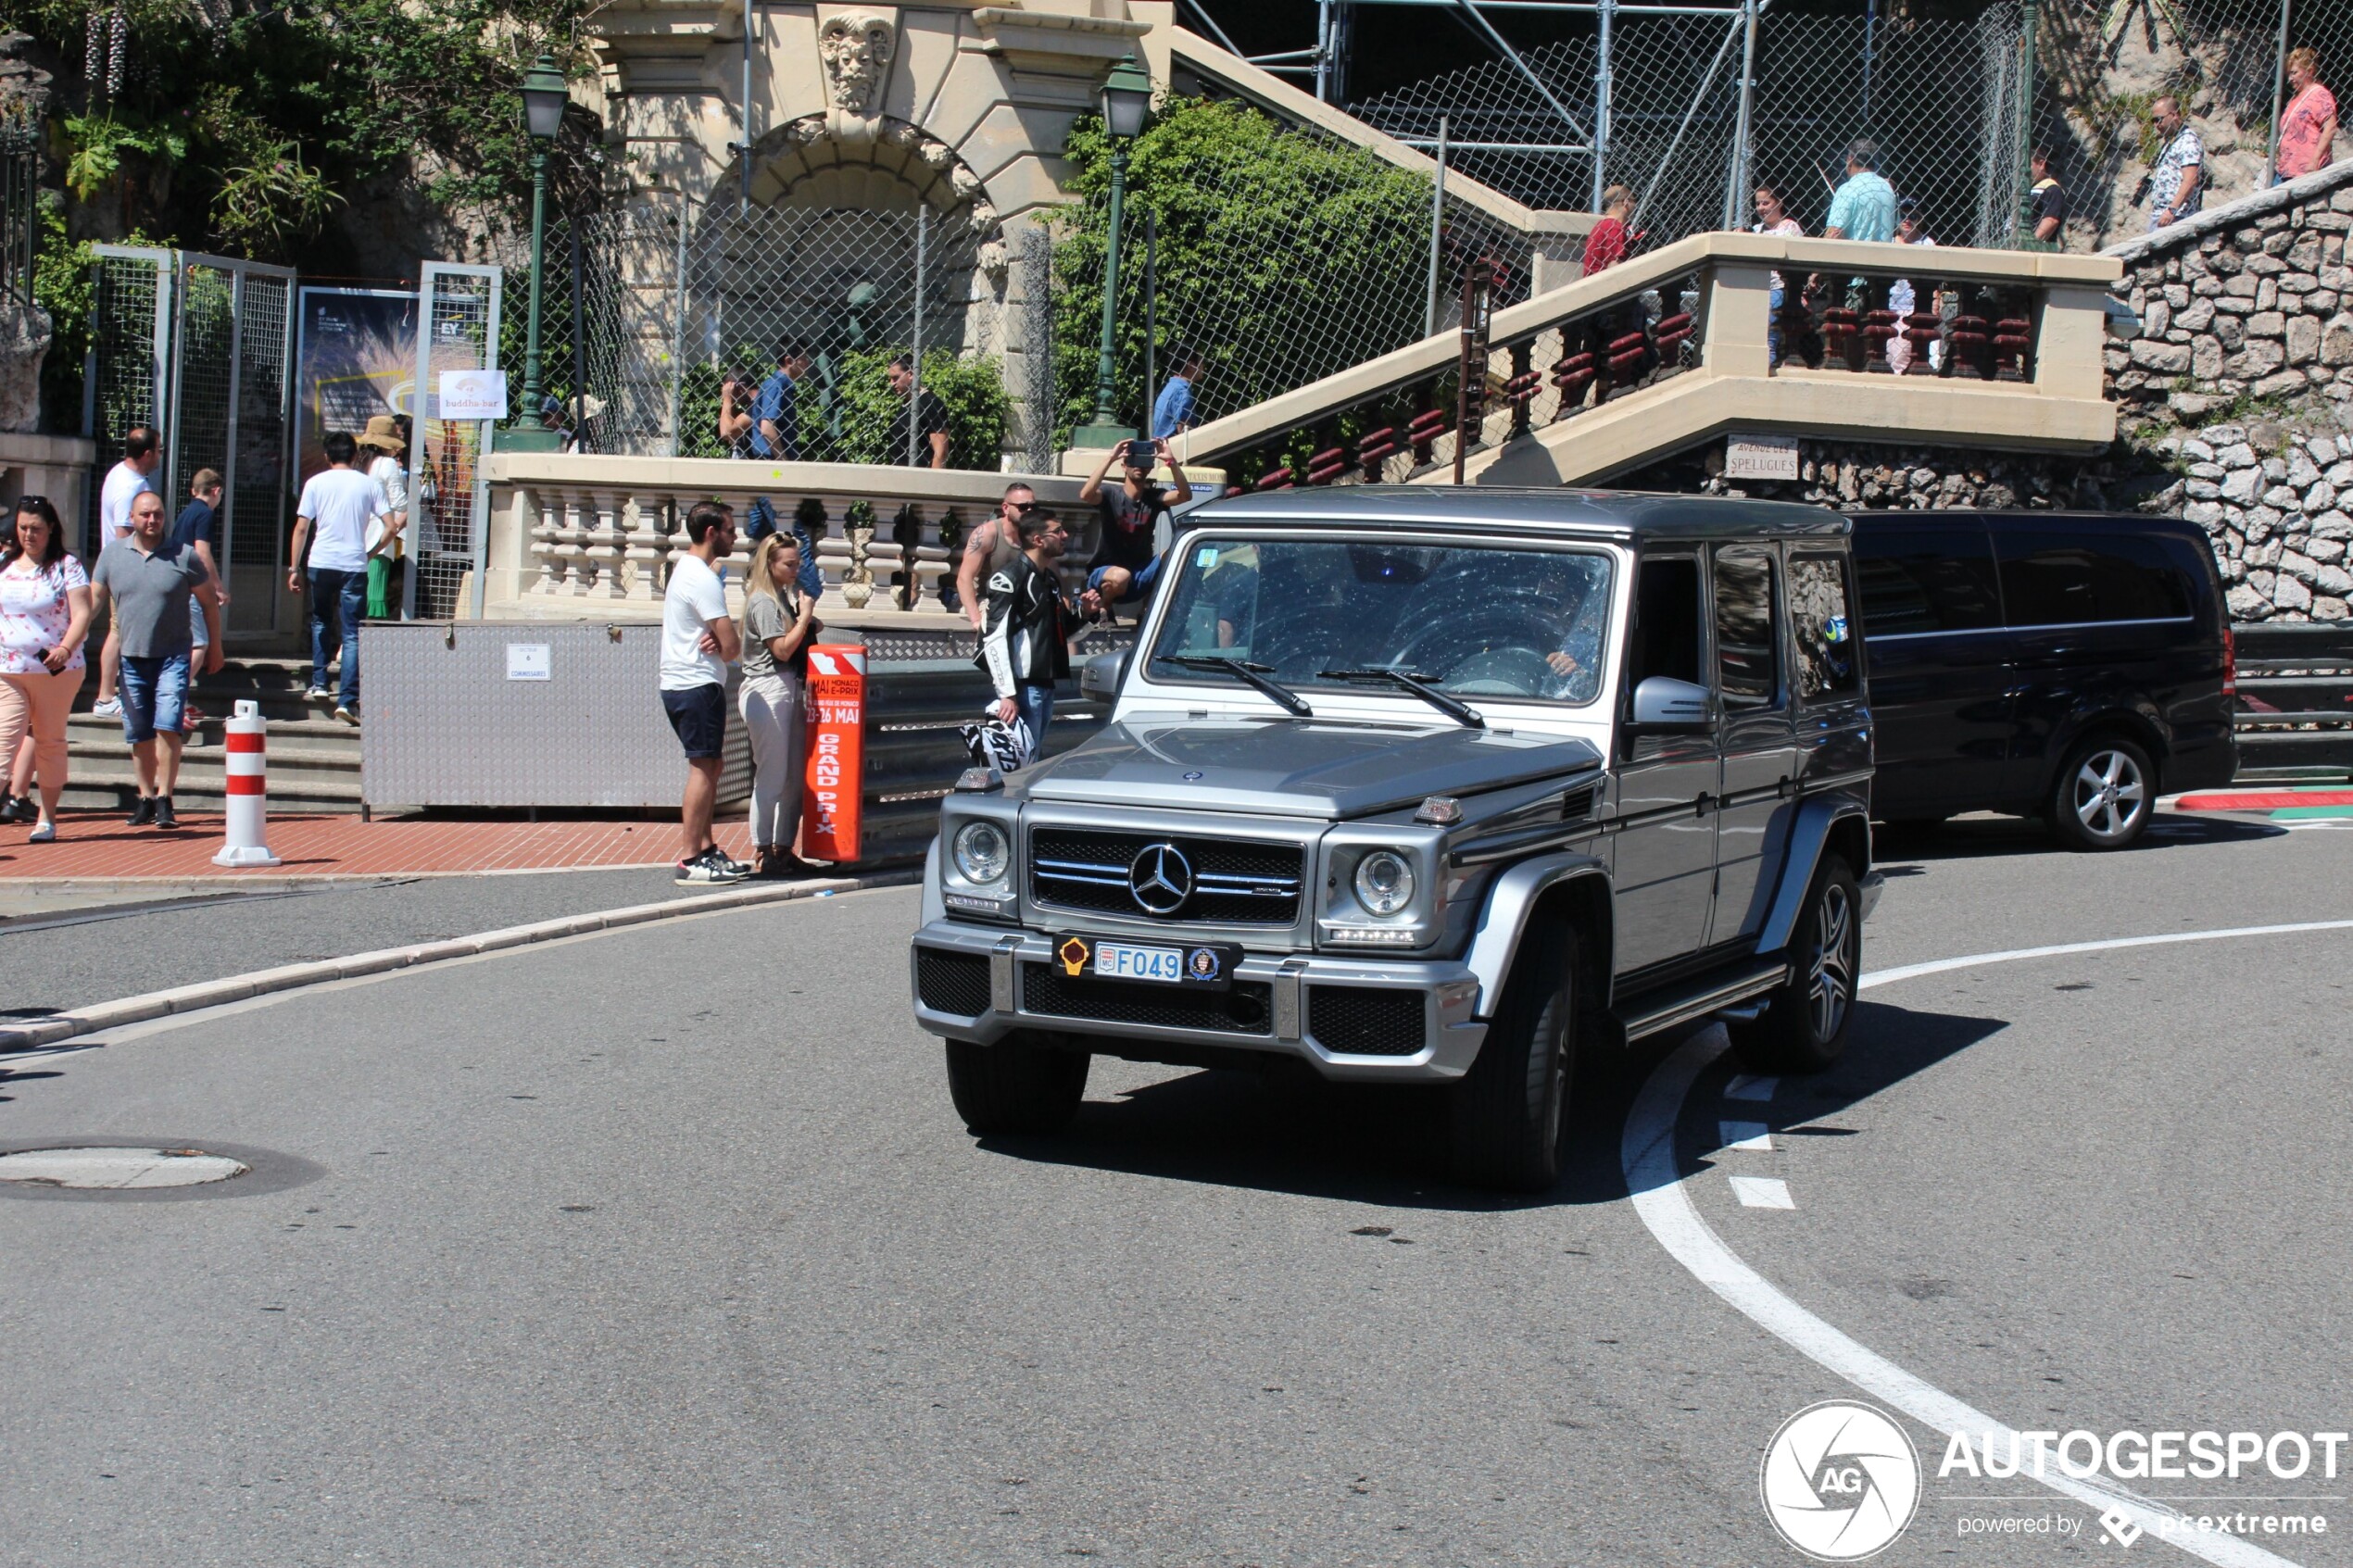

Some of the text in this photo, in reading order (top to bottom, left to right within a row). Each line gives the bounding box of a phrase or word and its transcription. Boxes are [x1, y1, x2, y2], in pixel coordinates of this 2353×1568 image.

[441, 322, 459, 334] EY
[446, 399, 497, 408] buddha-bar
[1738, 444, 1789, 454] AVENUE DES
[831, 686, 859, 695] E-PRIX
[807, 707, 860, 724] 23-26 MAI
[815, 734, 840, 834] GRAND PRIX
[1117, 949, 1178, 979] F049
